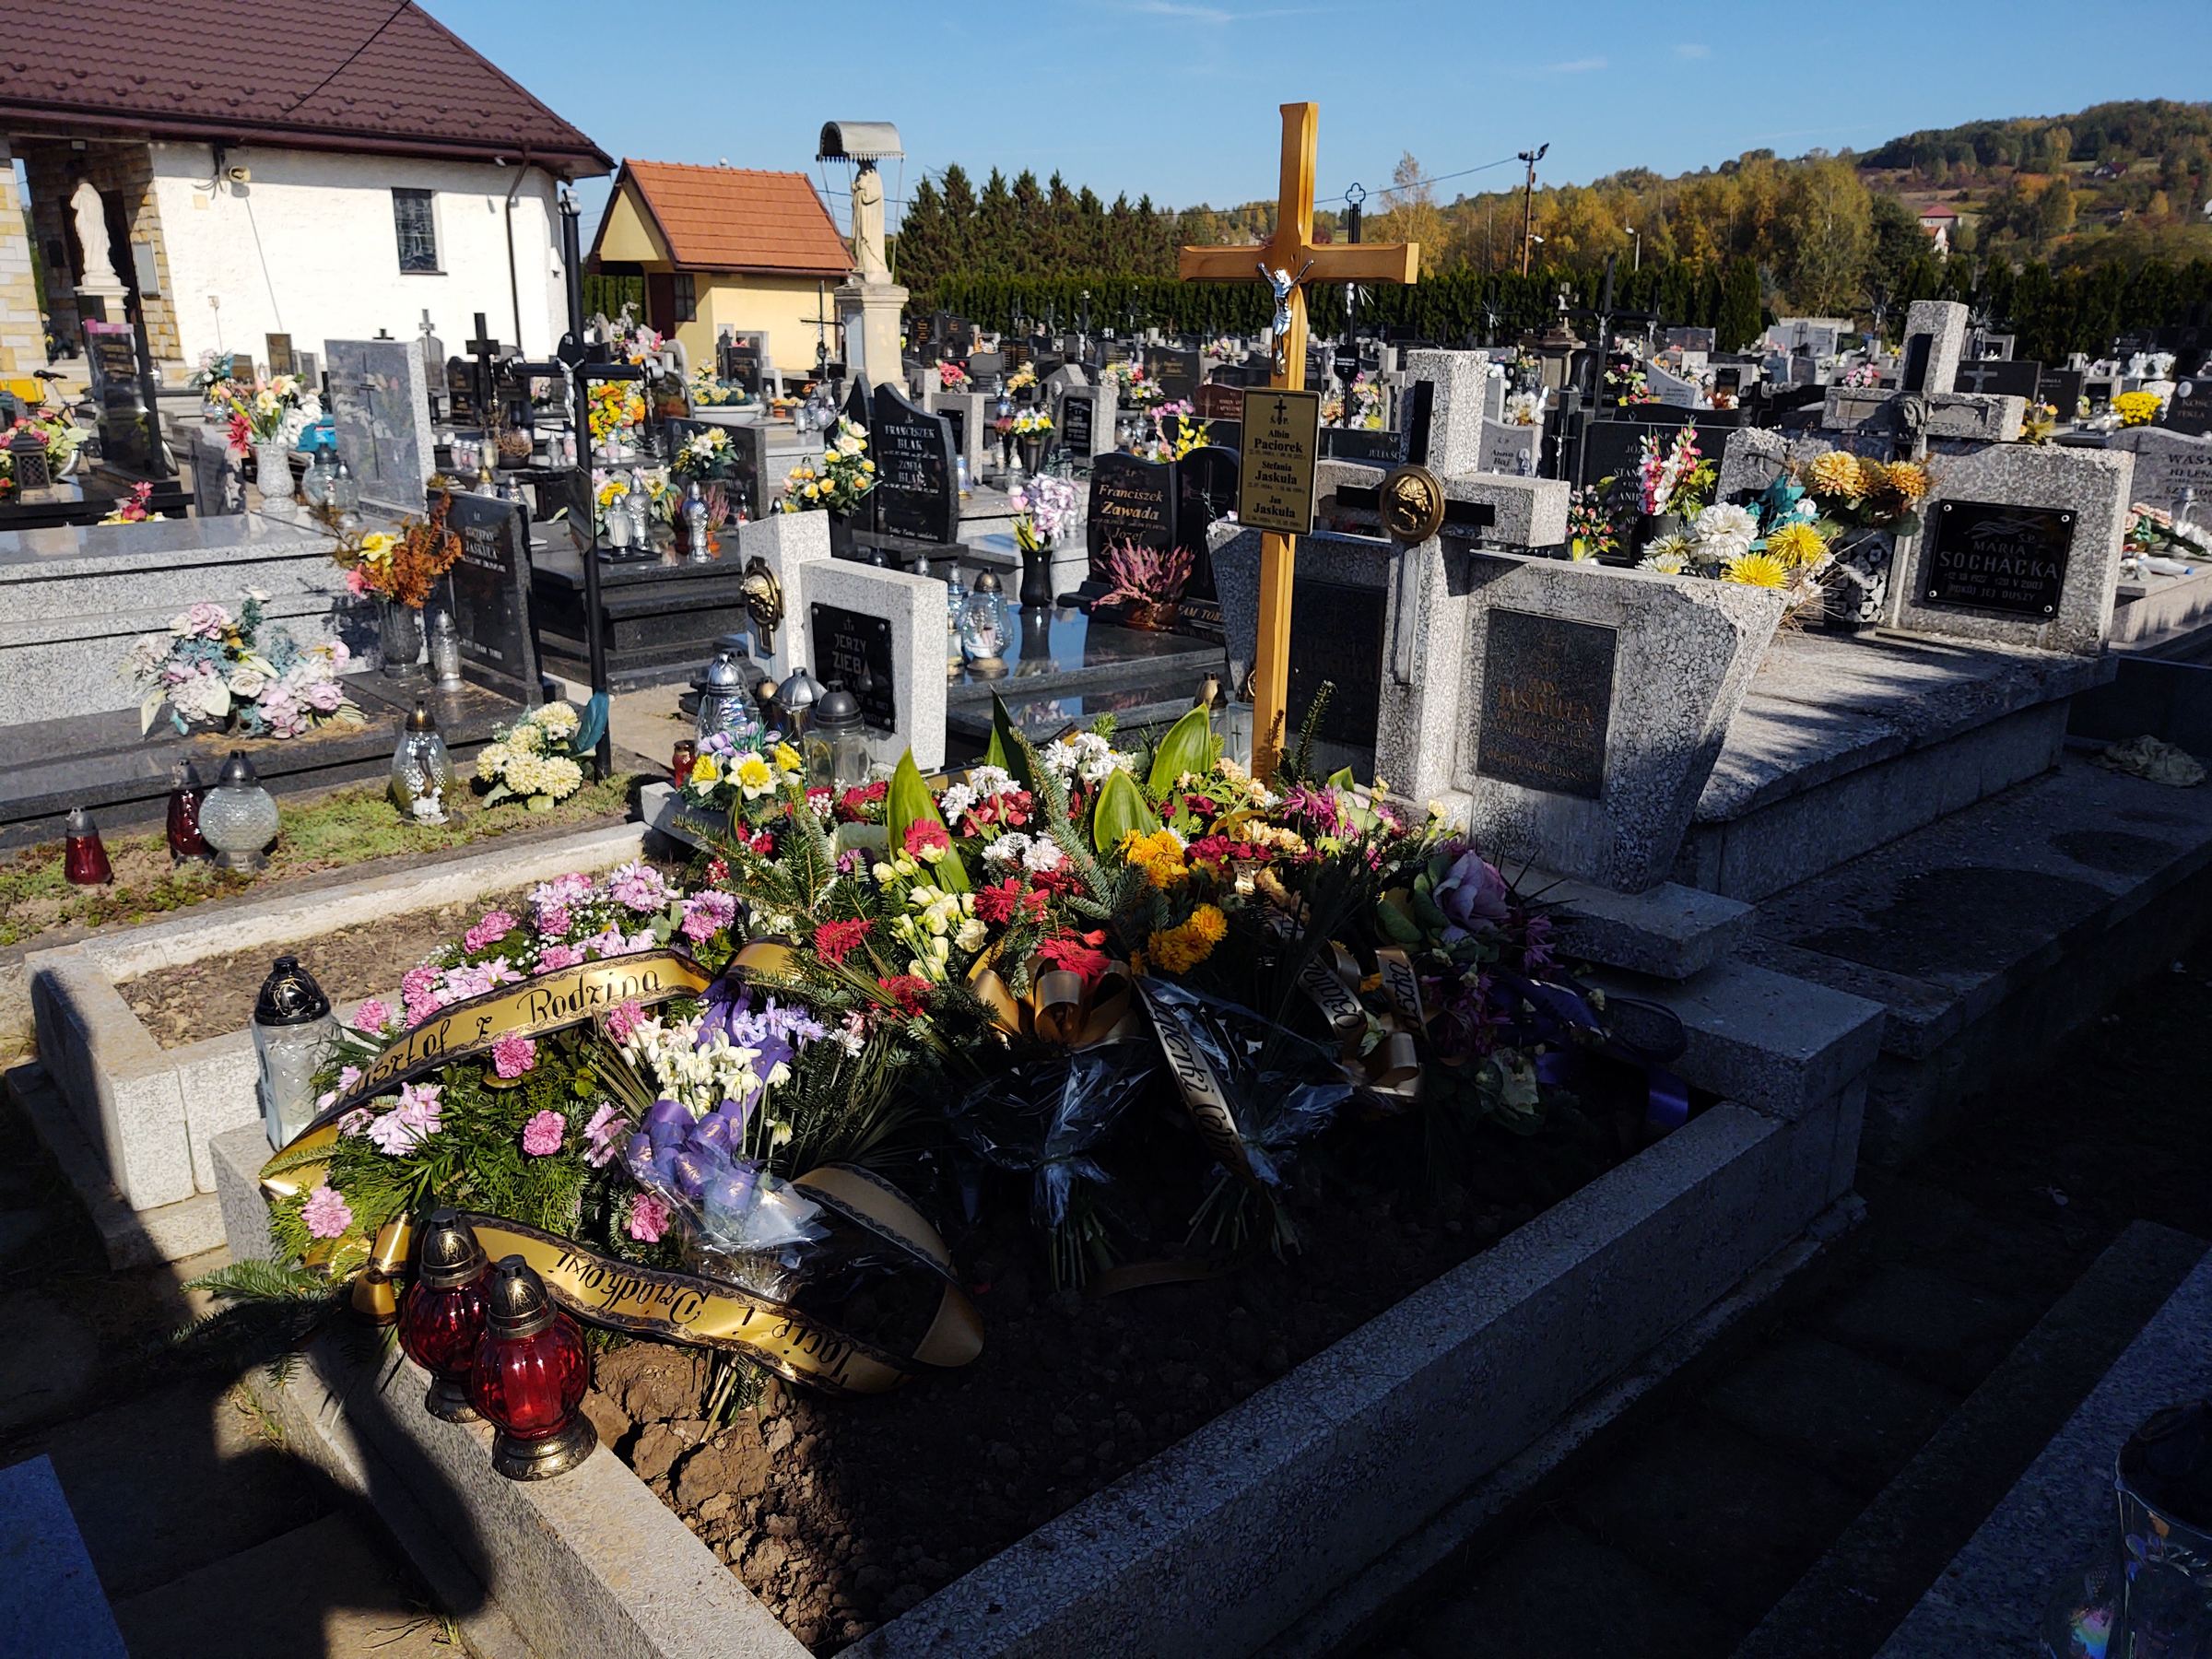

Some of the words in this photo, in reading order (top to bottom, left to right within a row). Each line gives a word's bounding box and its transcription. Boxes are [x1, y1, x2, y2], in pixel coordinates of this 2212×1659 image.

[884, 425, 935, 439] FRANCISZEK
[1267, 429, 1289, 439] Albin
[897, 438, 924, 451] BLAK
[1253, 438, 1303, 453] Paciorek
[1262, 461, 1292, 472] Stefania
[1254, 470, 1298, 486] Jaskuła
[1098, 484, 1165, 503] Franciszek
[1269, 495, 1282, 505] Jan
[1100, 500, 1160, 521] Zawada
[1253, 502, 1296, 519] Jaskuła
[1972, 541, 2027, 556] MARIA
[1938, 551, 2059, 580] SOCHACKA
[834, 632, 867, 653] JERZY
[345, 1018, 451, 1097] ysztof
[476, 1016, 493, 1038] z
[516, 970, 664, 1026] Rodzina
[547, 1250, 711, 1326] Dziadkowi
[732, 1305, 756, 1335] i
[772, 1317, 856, 1388] Tacie
